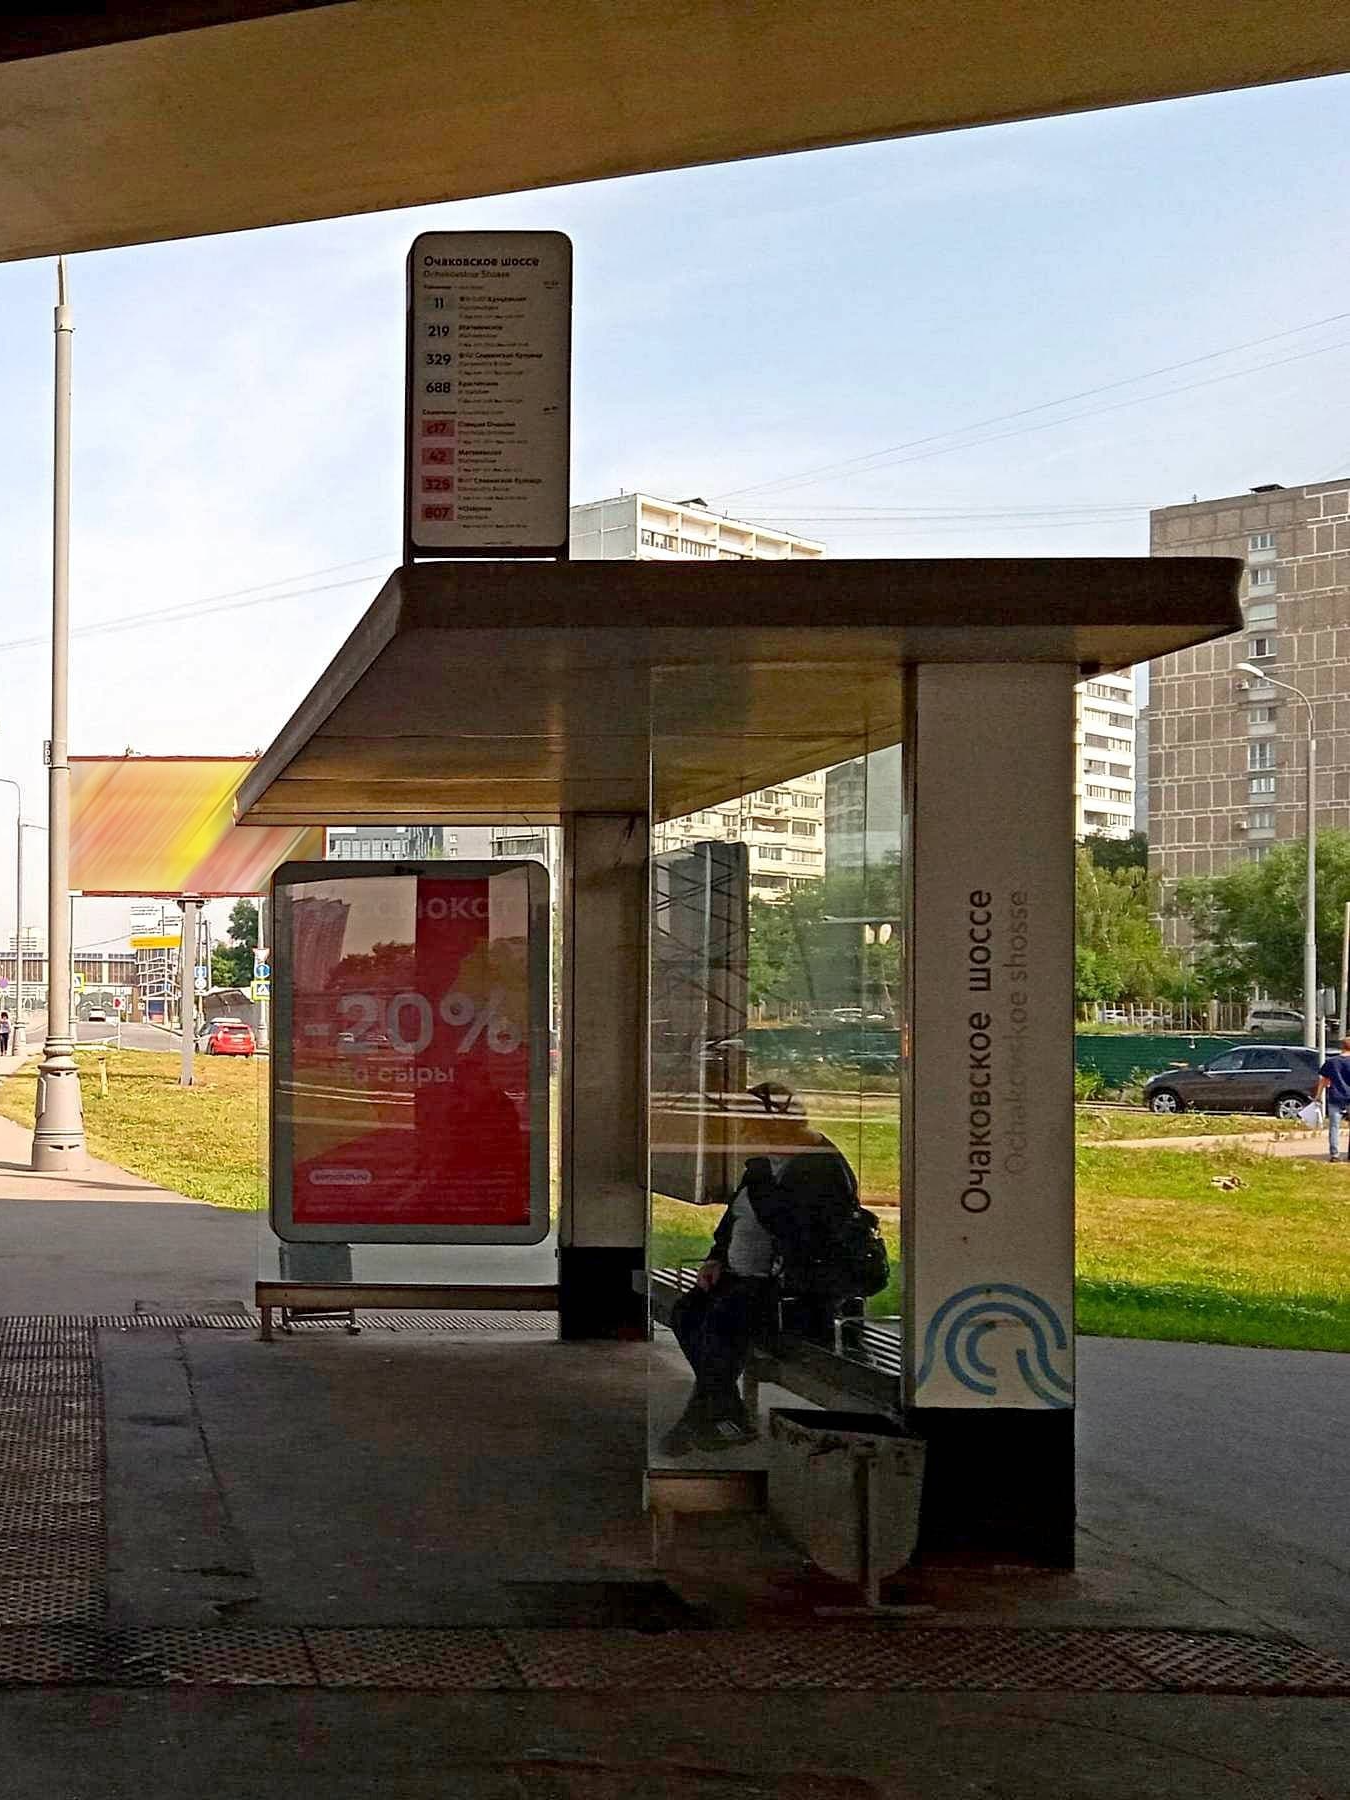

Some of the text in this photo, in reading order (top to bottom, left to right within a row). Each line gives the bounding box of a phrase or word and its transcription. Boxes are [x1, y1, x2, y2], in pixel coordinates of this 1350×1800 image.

[424, 255, 540, 267] Очаковское шоссе
[428, 325, 450, 337] 219
[426, 353, 452, 365] 329
[426, 382, 451, 393] 688
[1003, 889, 1028, 987] shosse
[960, 889, 992, 1214] Очаковское шоссе
[377, 1066, 455, 1089] сыры
